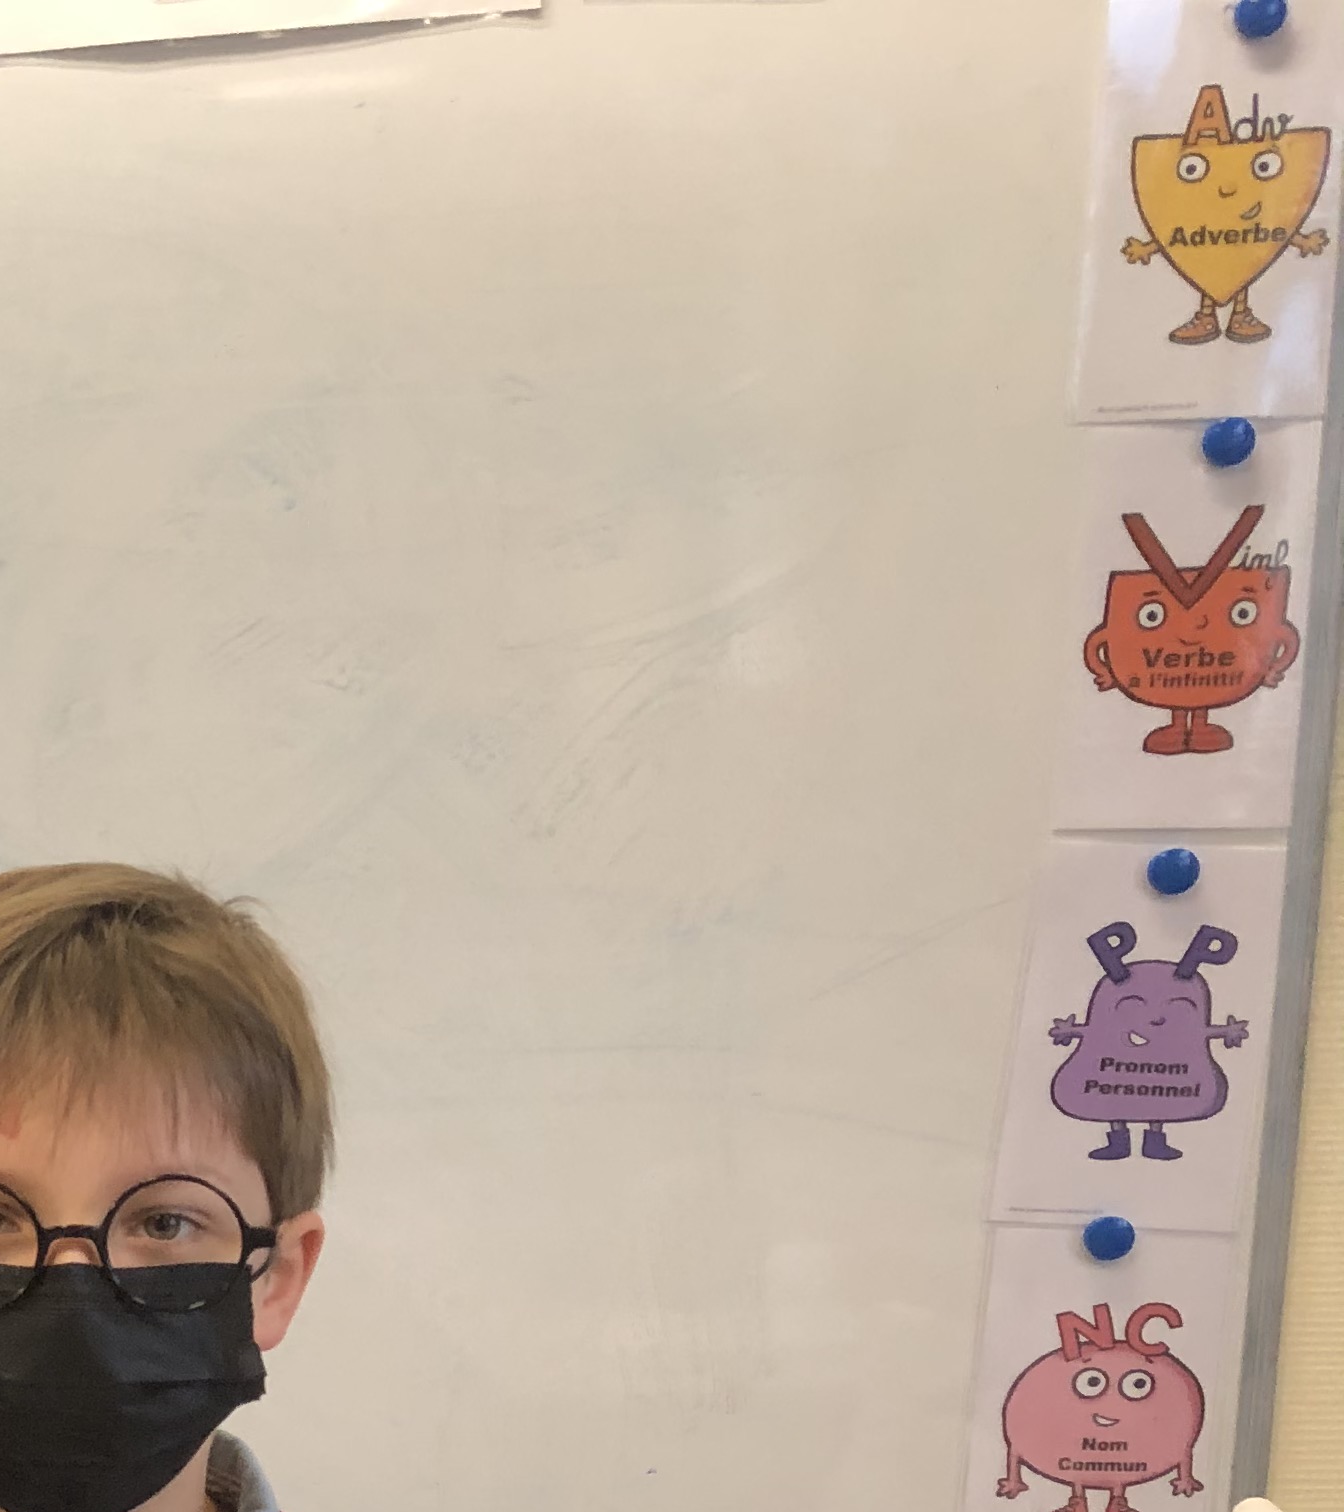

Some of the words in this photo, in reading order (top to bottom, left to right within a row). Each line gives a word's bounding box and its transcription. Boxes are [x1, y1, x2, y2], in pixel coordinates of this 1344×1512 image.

[1169, 223, 1287, 247] Adverbe
[1142, 647, 1236, 669] Verbe
[1100, 1057, 1189, 1075] Pronom
[1083, 1079, 1201, 1098] Personnel
[1082, 1437, 1128, 1451] Nom
[1058, 1457, 1147, 1472] Commun
